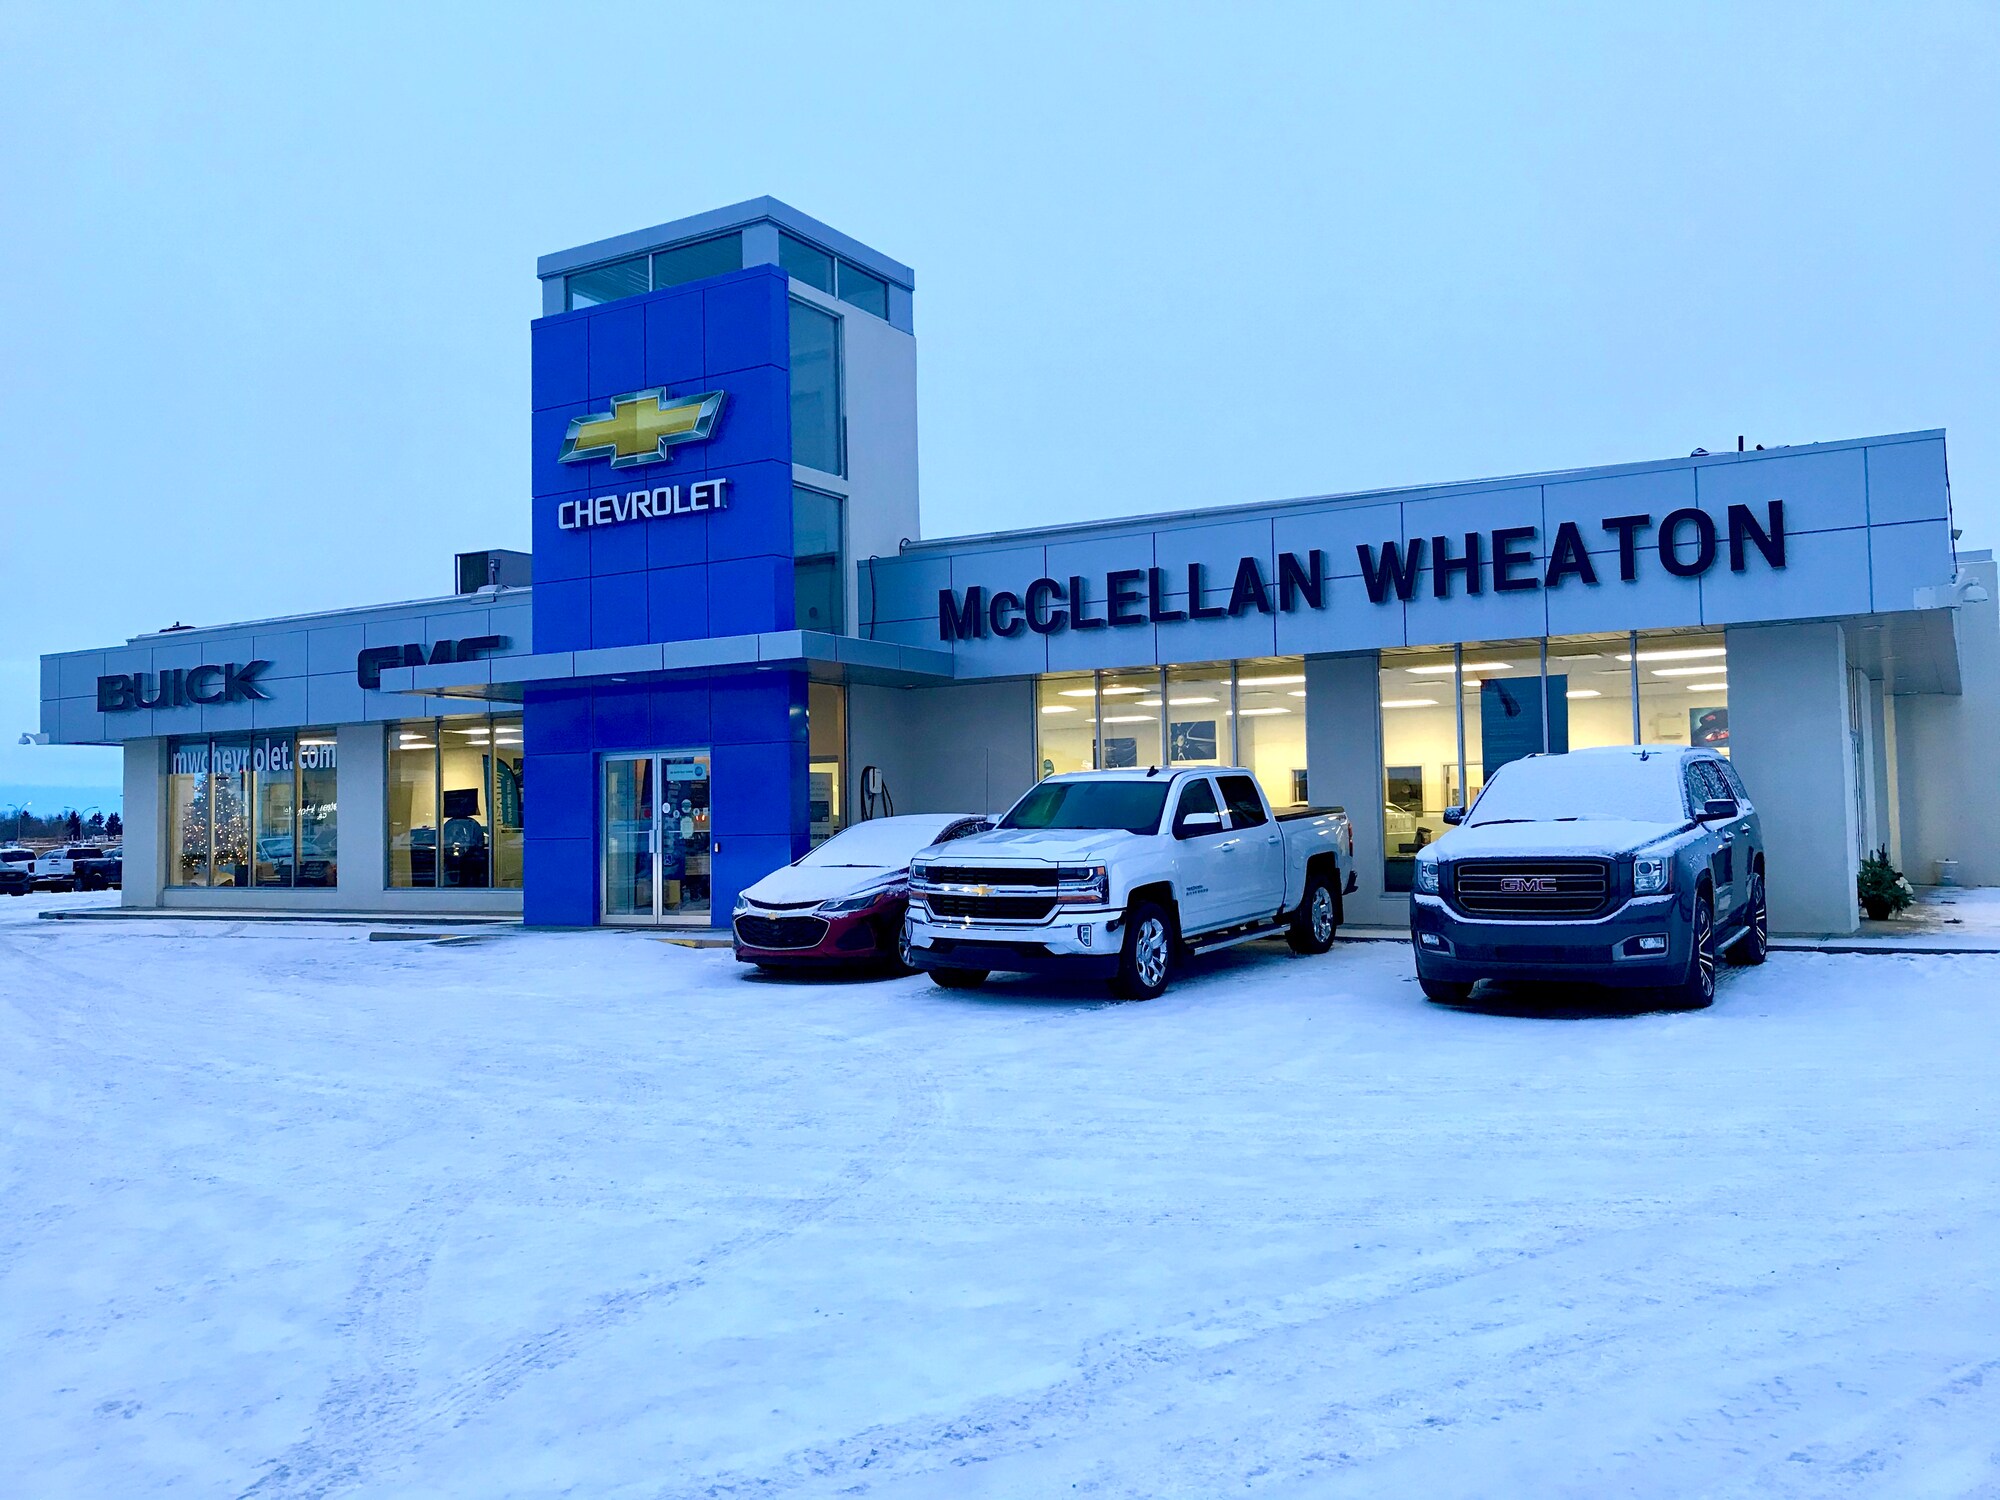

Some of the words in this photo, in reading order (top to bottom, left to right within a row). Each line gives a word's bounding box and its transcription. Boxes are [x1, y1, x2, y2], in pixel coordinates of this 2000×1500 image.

[558, 477, 728, 530] CHEVROLET
[938, 548, 1327, 642] McCLELLAN
[1355, 499, 1787, 604] WHEATON
[96, 659, 273, 713] BUICK
[1500, 878, 1557, 892] GMC
